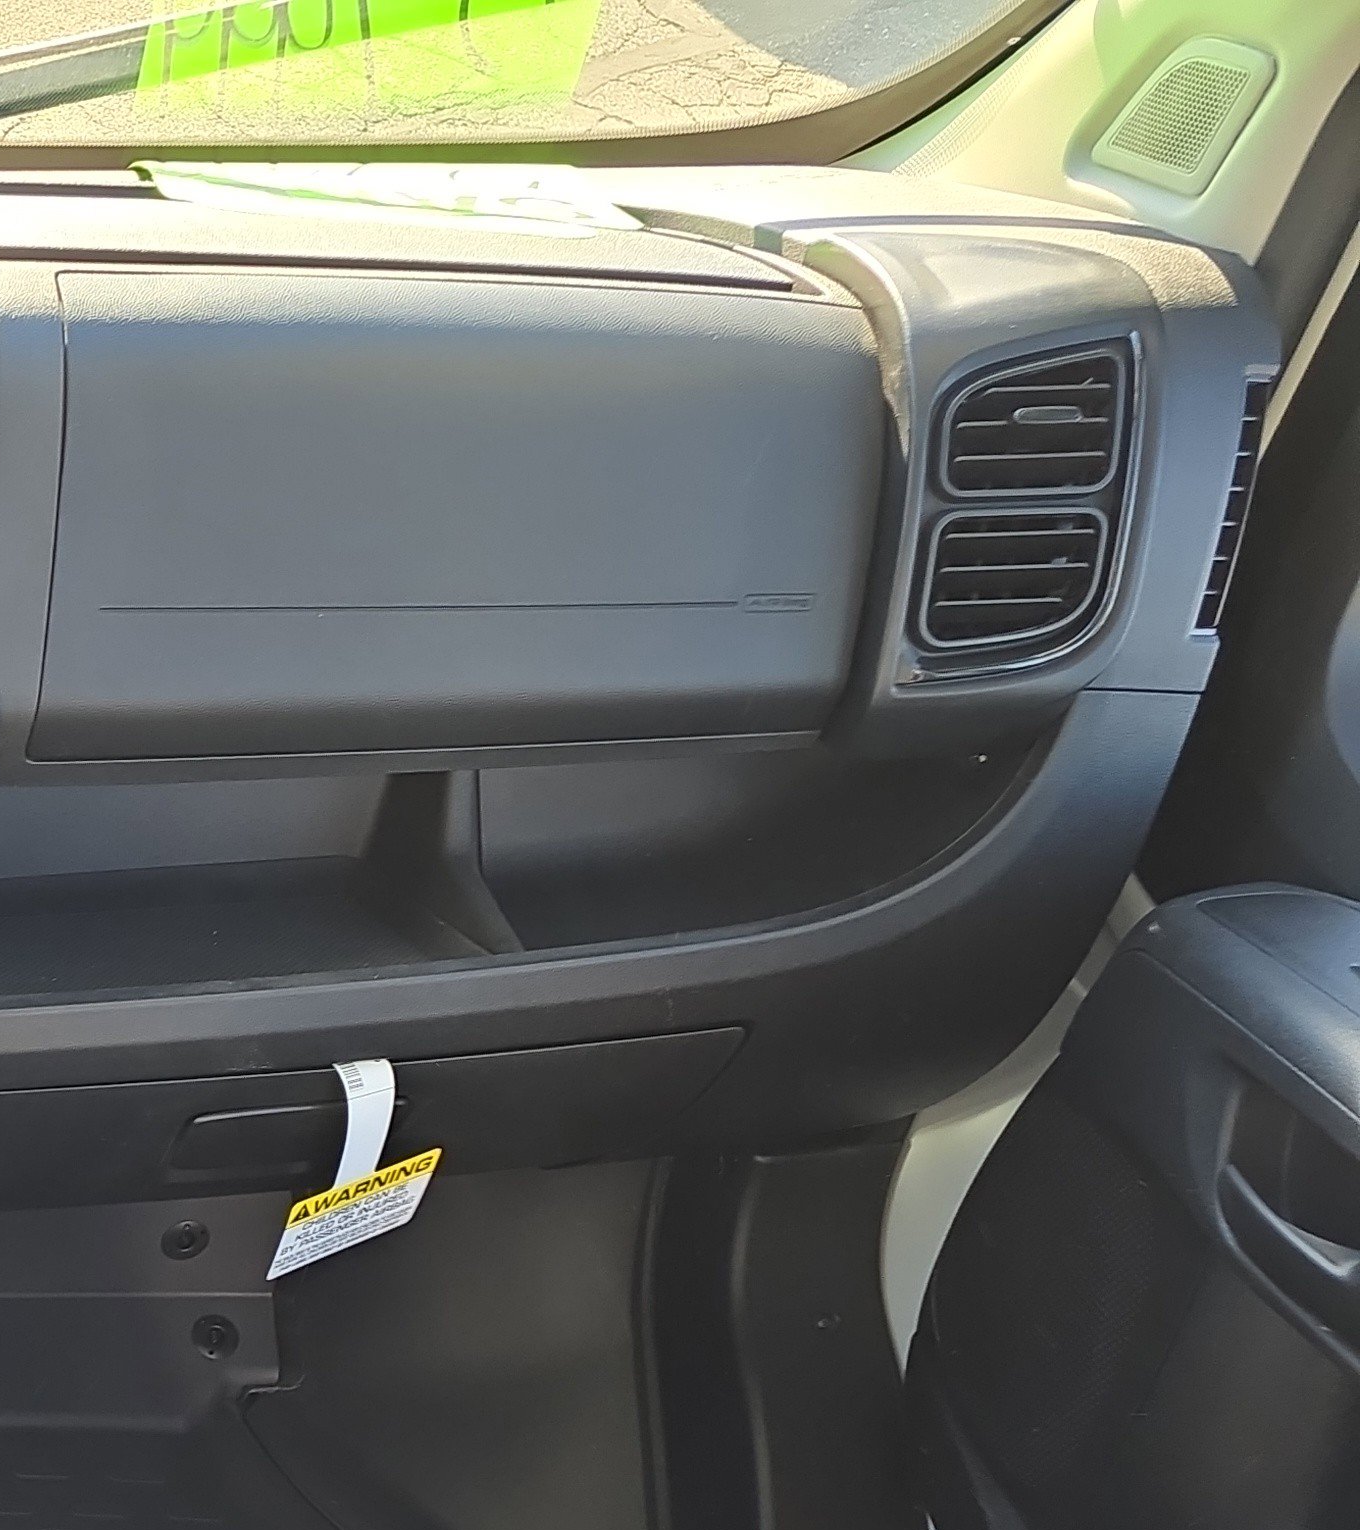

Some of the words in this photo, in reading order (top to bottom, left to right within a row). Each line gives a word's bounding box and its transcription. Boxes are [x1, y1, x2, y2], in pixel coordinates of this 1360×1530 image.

[314, 1155, 434, 1213] WARNING
[294, 1218, 335, 1242] KILLED
[301, 1200, 362, 1231] CHILDREN
[279, 1242, 296, 1256] BY
[298, 1213, 369, 1248] PASSENGER
